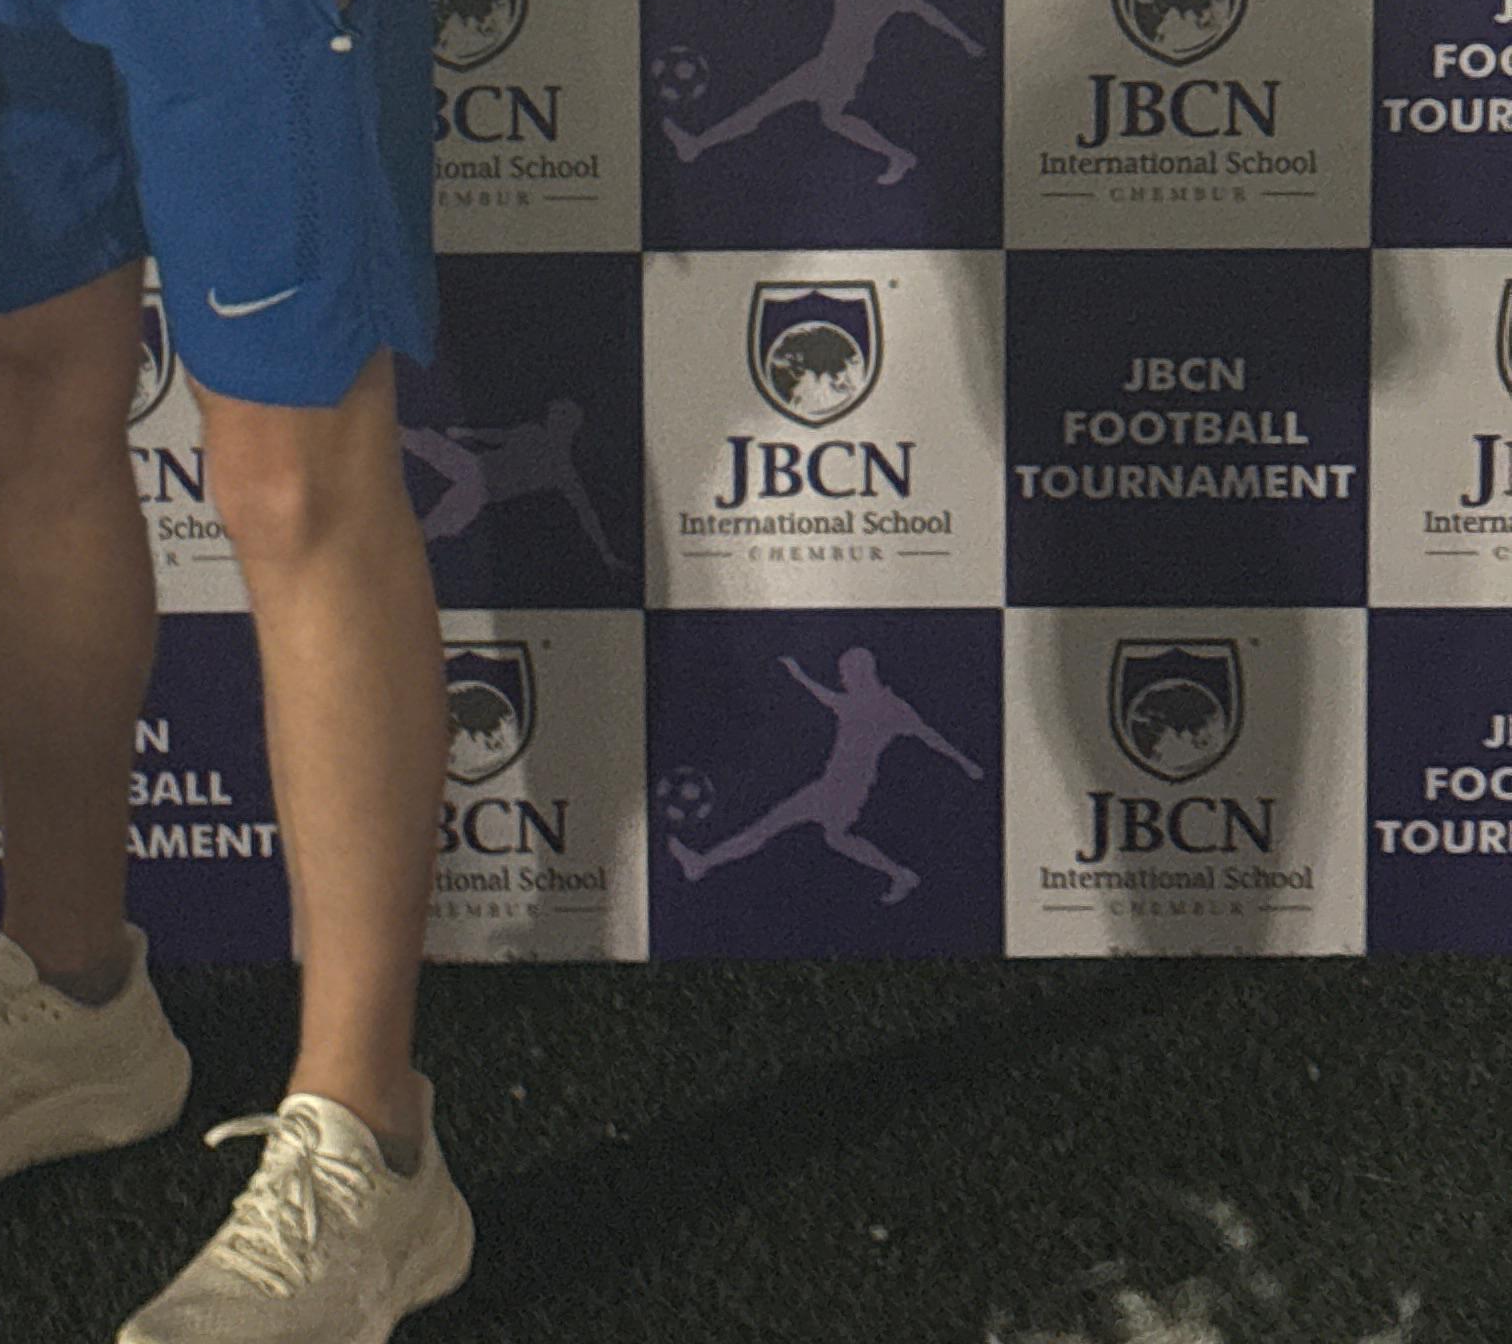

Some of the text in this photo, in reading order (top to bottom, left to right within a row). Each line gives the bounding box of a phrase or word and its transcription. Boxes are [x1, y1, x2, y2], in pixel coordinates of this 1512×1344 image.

[1077, 74, 1280, 149] JBCN
[509, 154, 600, 180] School
[1040, 149, 1317, 175] International School
[1124, 358, 1244, 391] JBCN
[1065, 411, 1309, 445] FOOTBALL
[716, 436, 915, 509] JBCN
[1016, 465, 1356, 498] TOURNAMENT
[679, 509, 951, 535] International School
[1076, 791, 1275, 864] JBCN
[518, 866, 607, 892] School
[1040, 865, 1313, 890] International School
